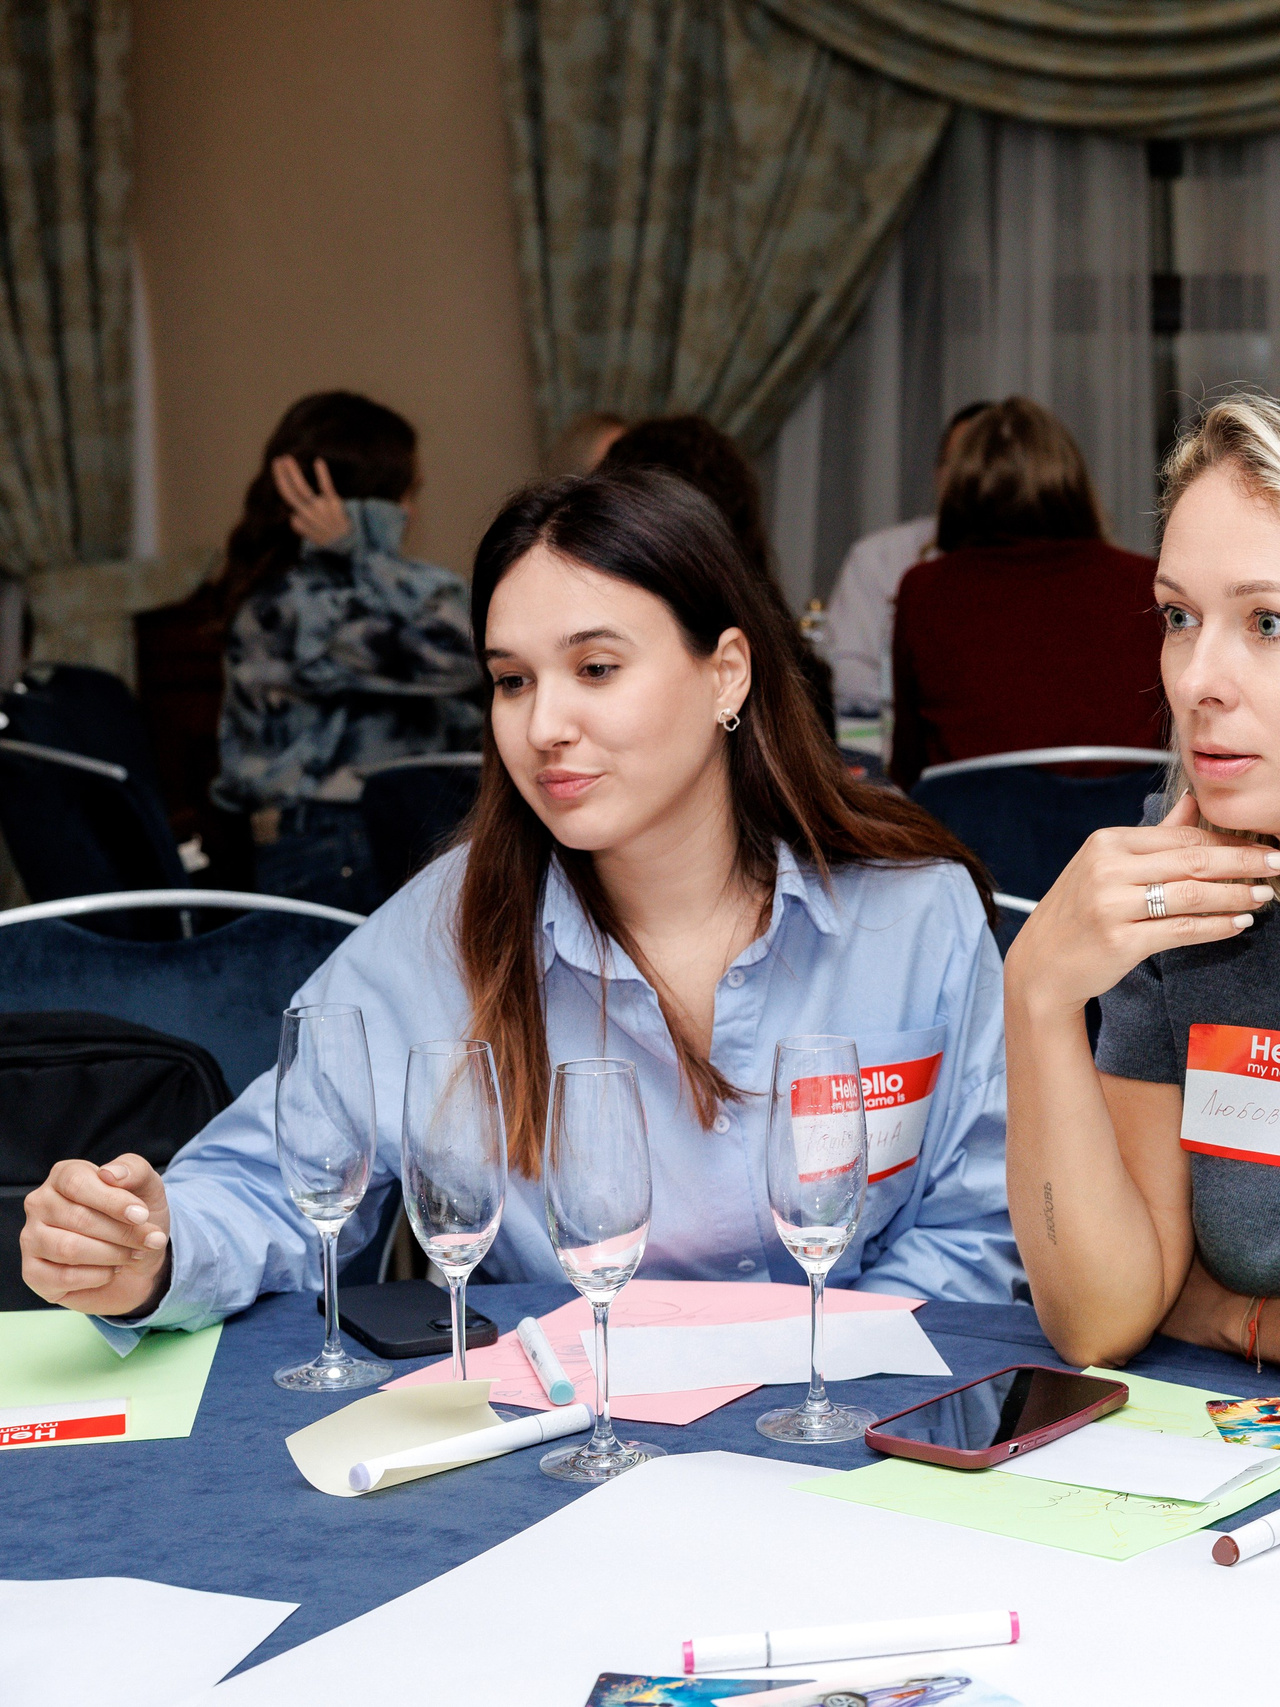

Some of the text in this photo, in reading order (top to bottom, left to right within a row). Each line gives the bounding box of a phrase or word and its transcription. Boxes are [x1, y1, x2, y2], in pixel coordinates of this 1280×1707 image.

[1247, 1062, 1266, 1077] my
[896, 1092, 906, 1104] is
[33, 1422, 59, 1430] my
[0, 1428, 56, 1444] Hel
